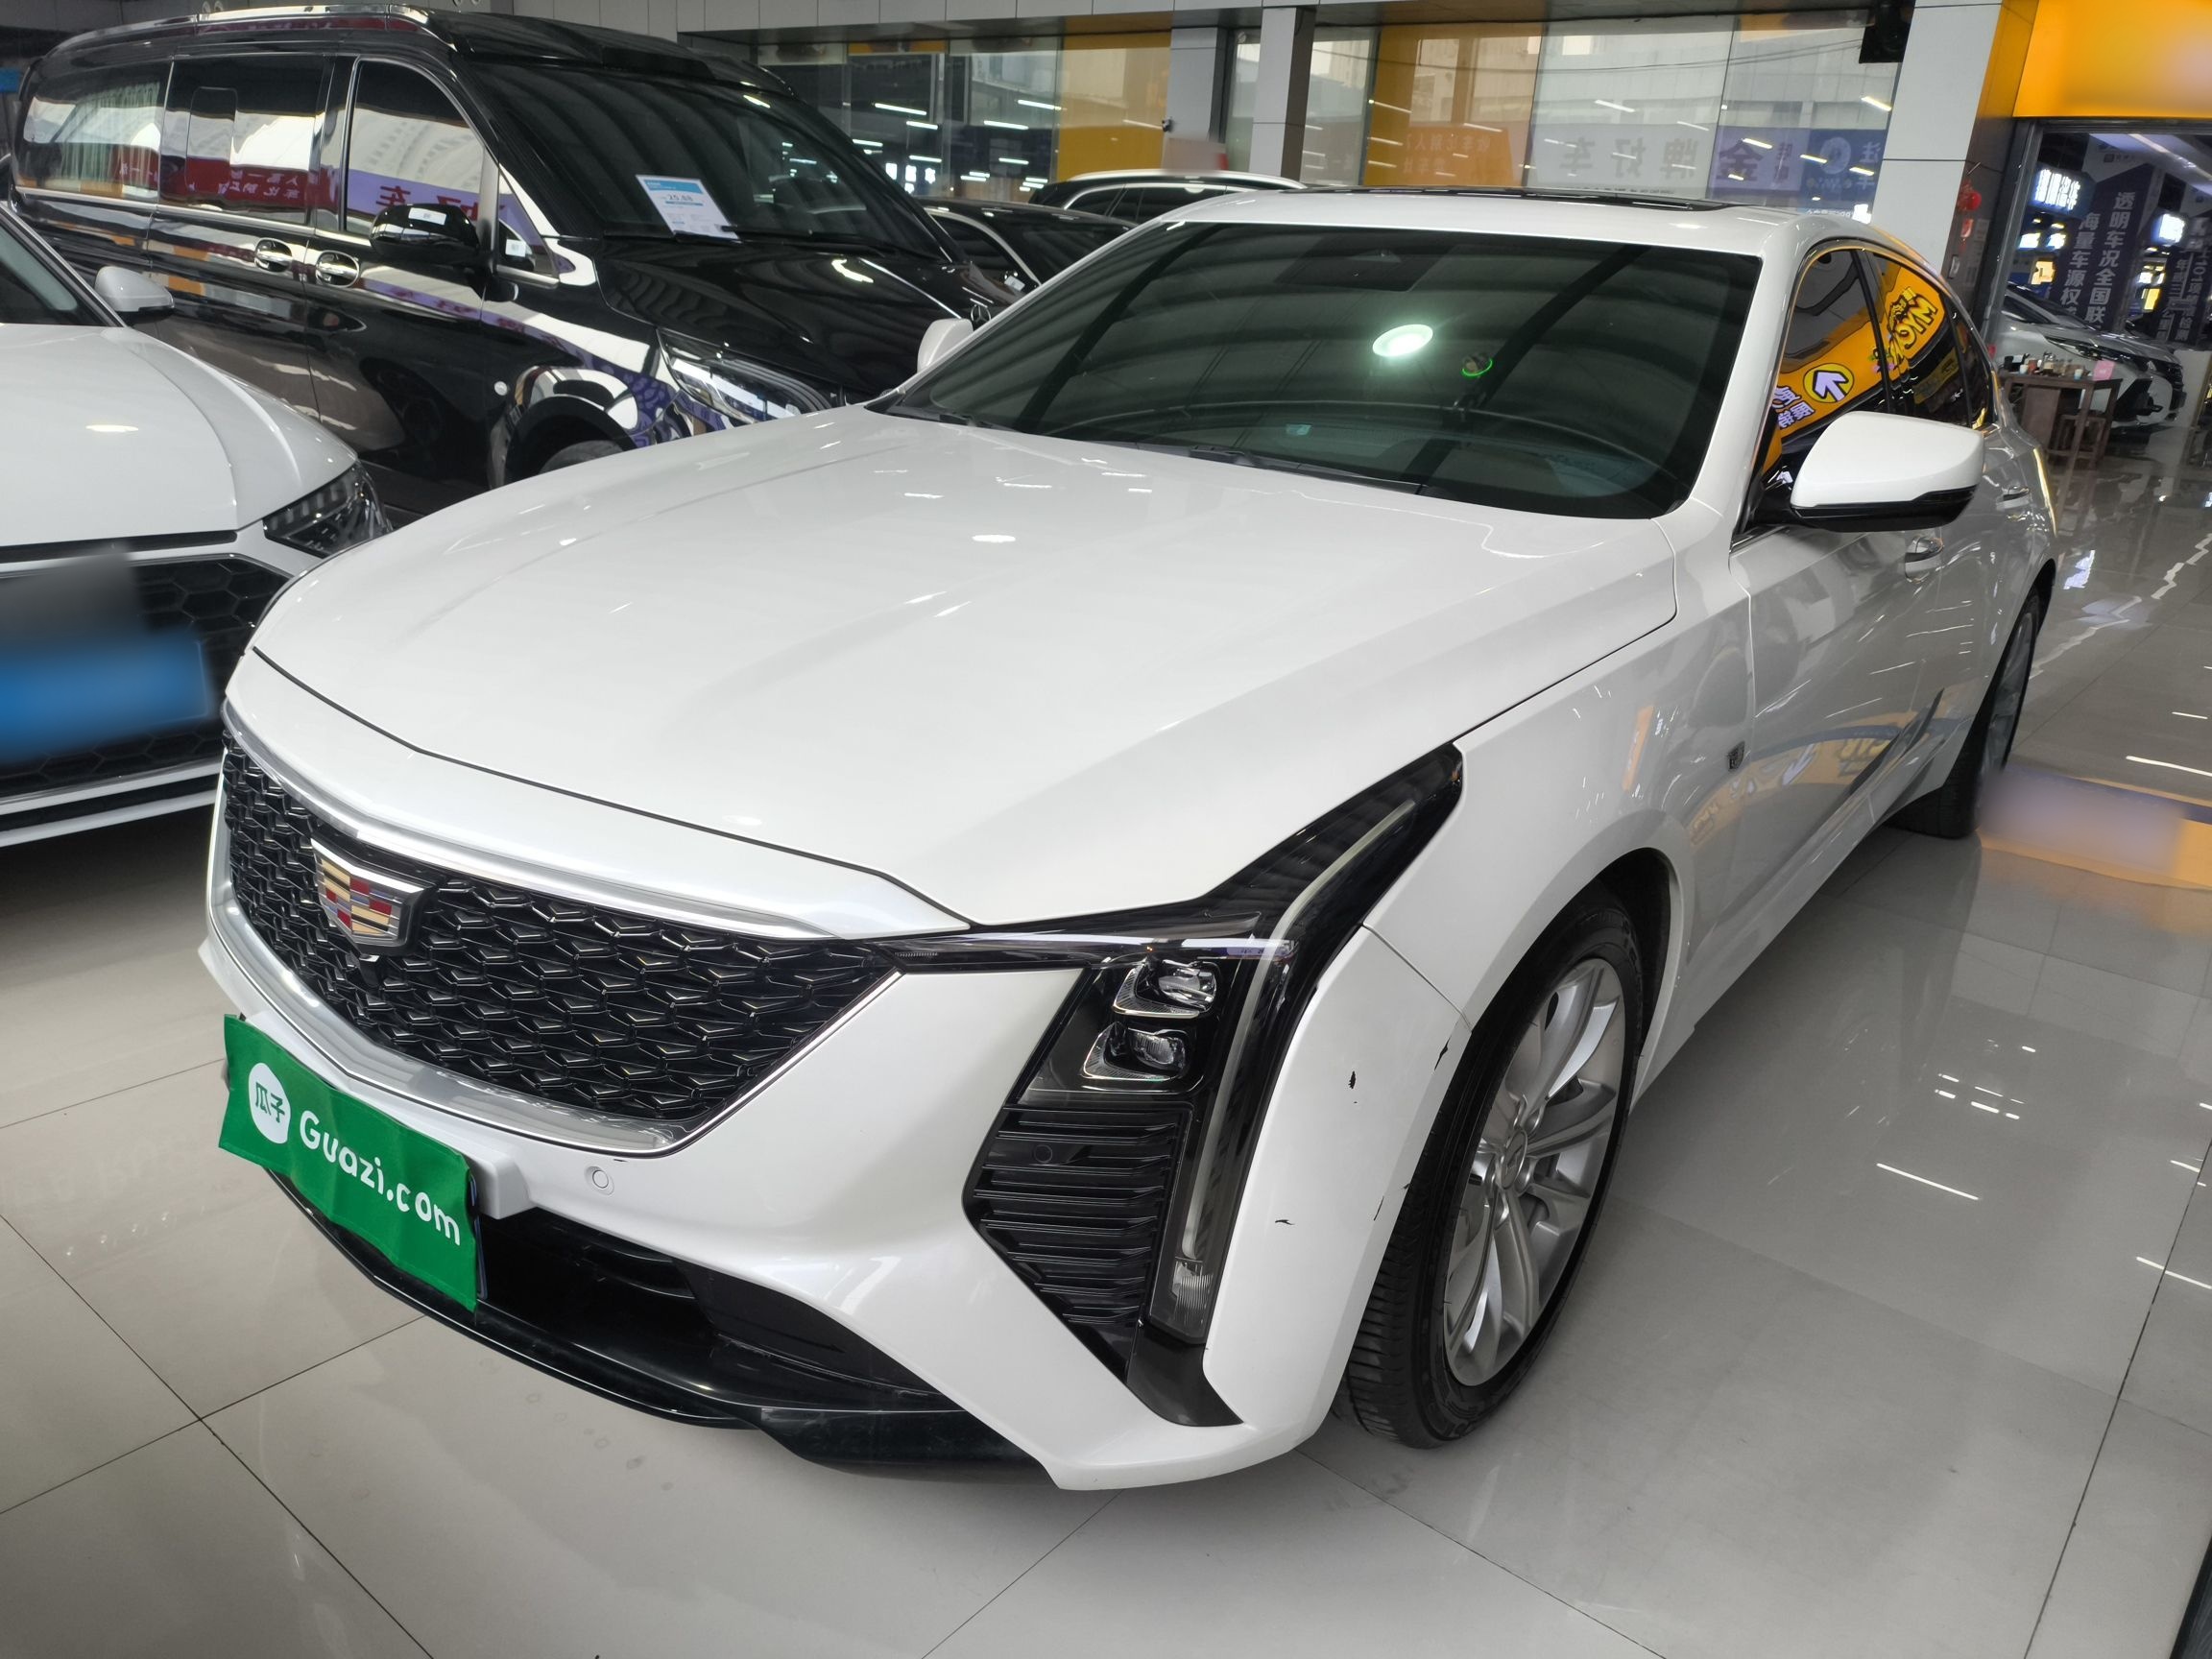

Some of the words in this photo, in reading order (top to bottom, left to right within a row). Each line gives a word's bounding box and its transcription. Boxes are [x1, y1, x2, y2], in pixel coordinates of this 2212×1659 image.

[2060, 212, 2101, 314] 海量车源权
[2084, 191, 2135, 329] 透明车况全国联
[255, 1081, 285, 1123] 瓜子
[300, 1110, 460, 1245] Guazi.com
